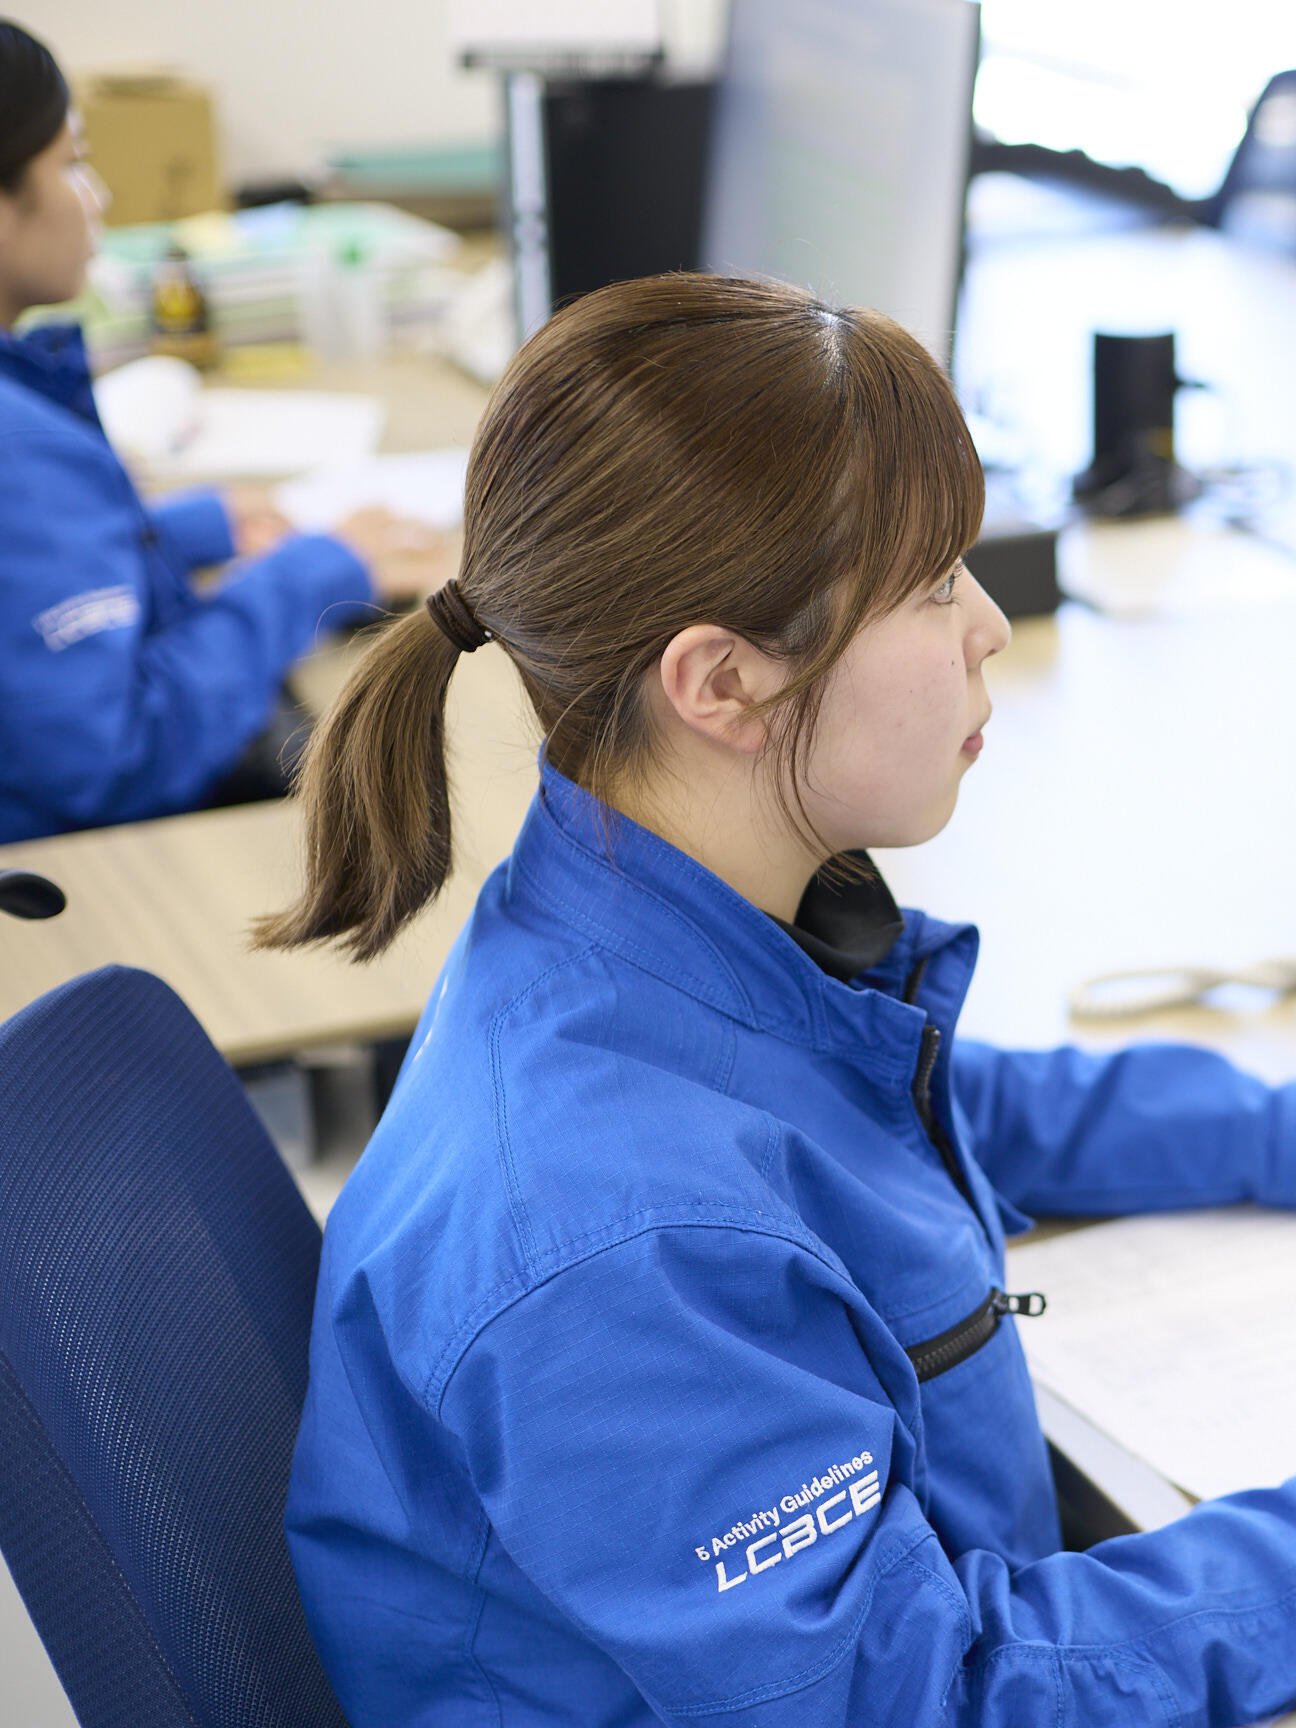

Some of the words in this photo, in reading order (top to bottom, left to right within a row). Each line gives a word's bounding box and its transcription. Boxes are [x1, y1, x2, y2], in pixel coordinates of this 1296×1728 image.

[694, 1546, 710, 1561] 5
[712, 1507, 780, 1556] Activity
[780, 1450, 873, 1513] Guidelines
